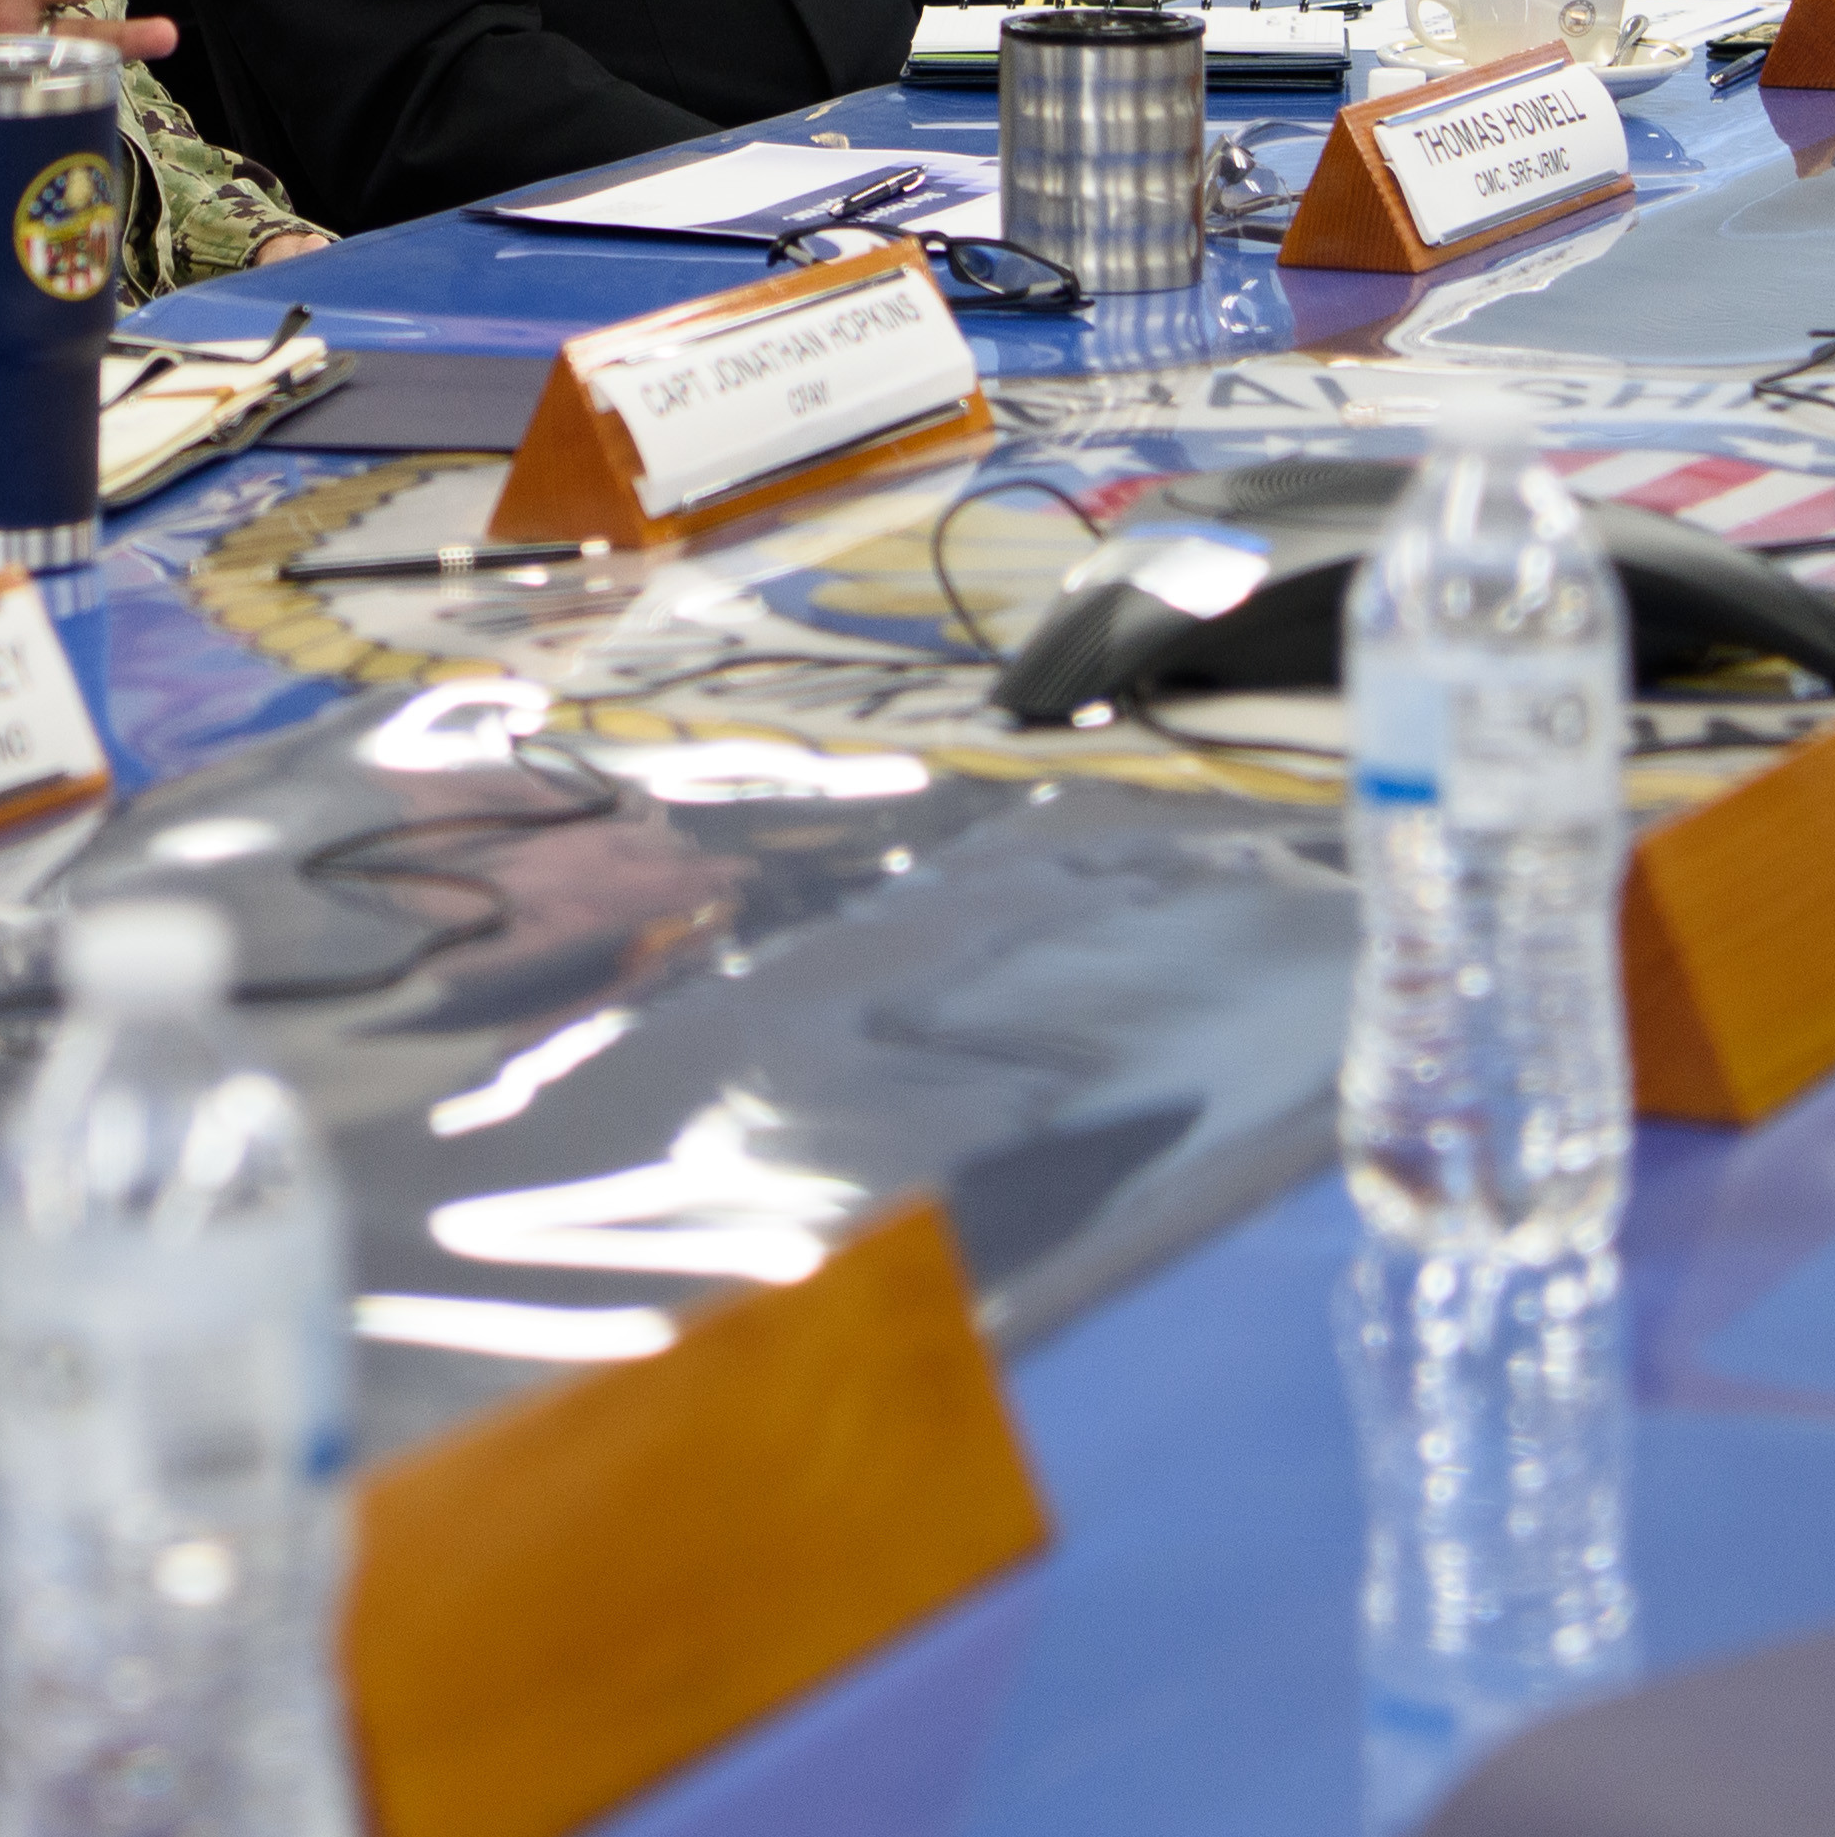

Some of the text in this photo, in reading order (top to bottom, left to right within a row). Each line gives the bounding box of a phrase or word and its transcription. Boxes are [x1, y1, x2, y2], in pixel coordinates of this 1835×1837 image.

[1413, 89, 1587, 166] THOMAS HOWELL
[1474, 147, 1571, 197] CMC, SRF-JRMC
[640, 291, 923, 418] CAPT JONATHAN HOPKINS
